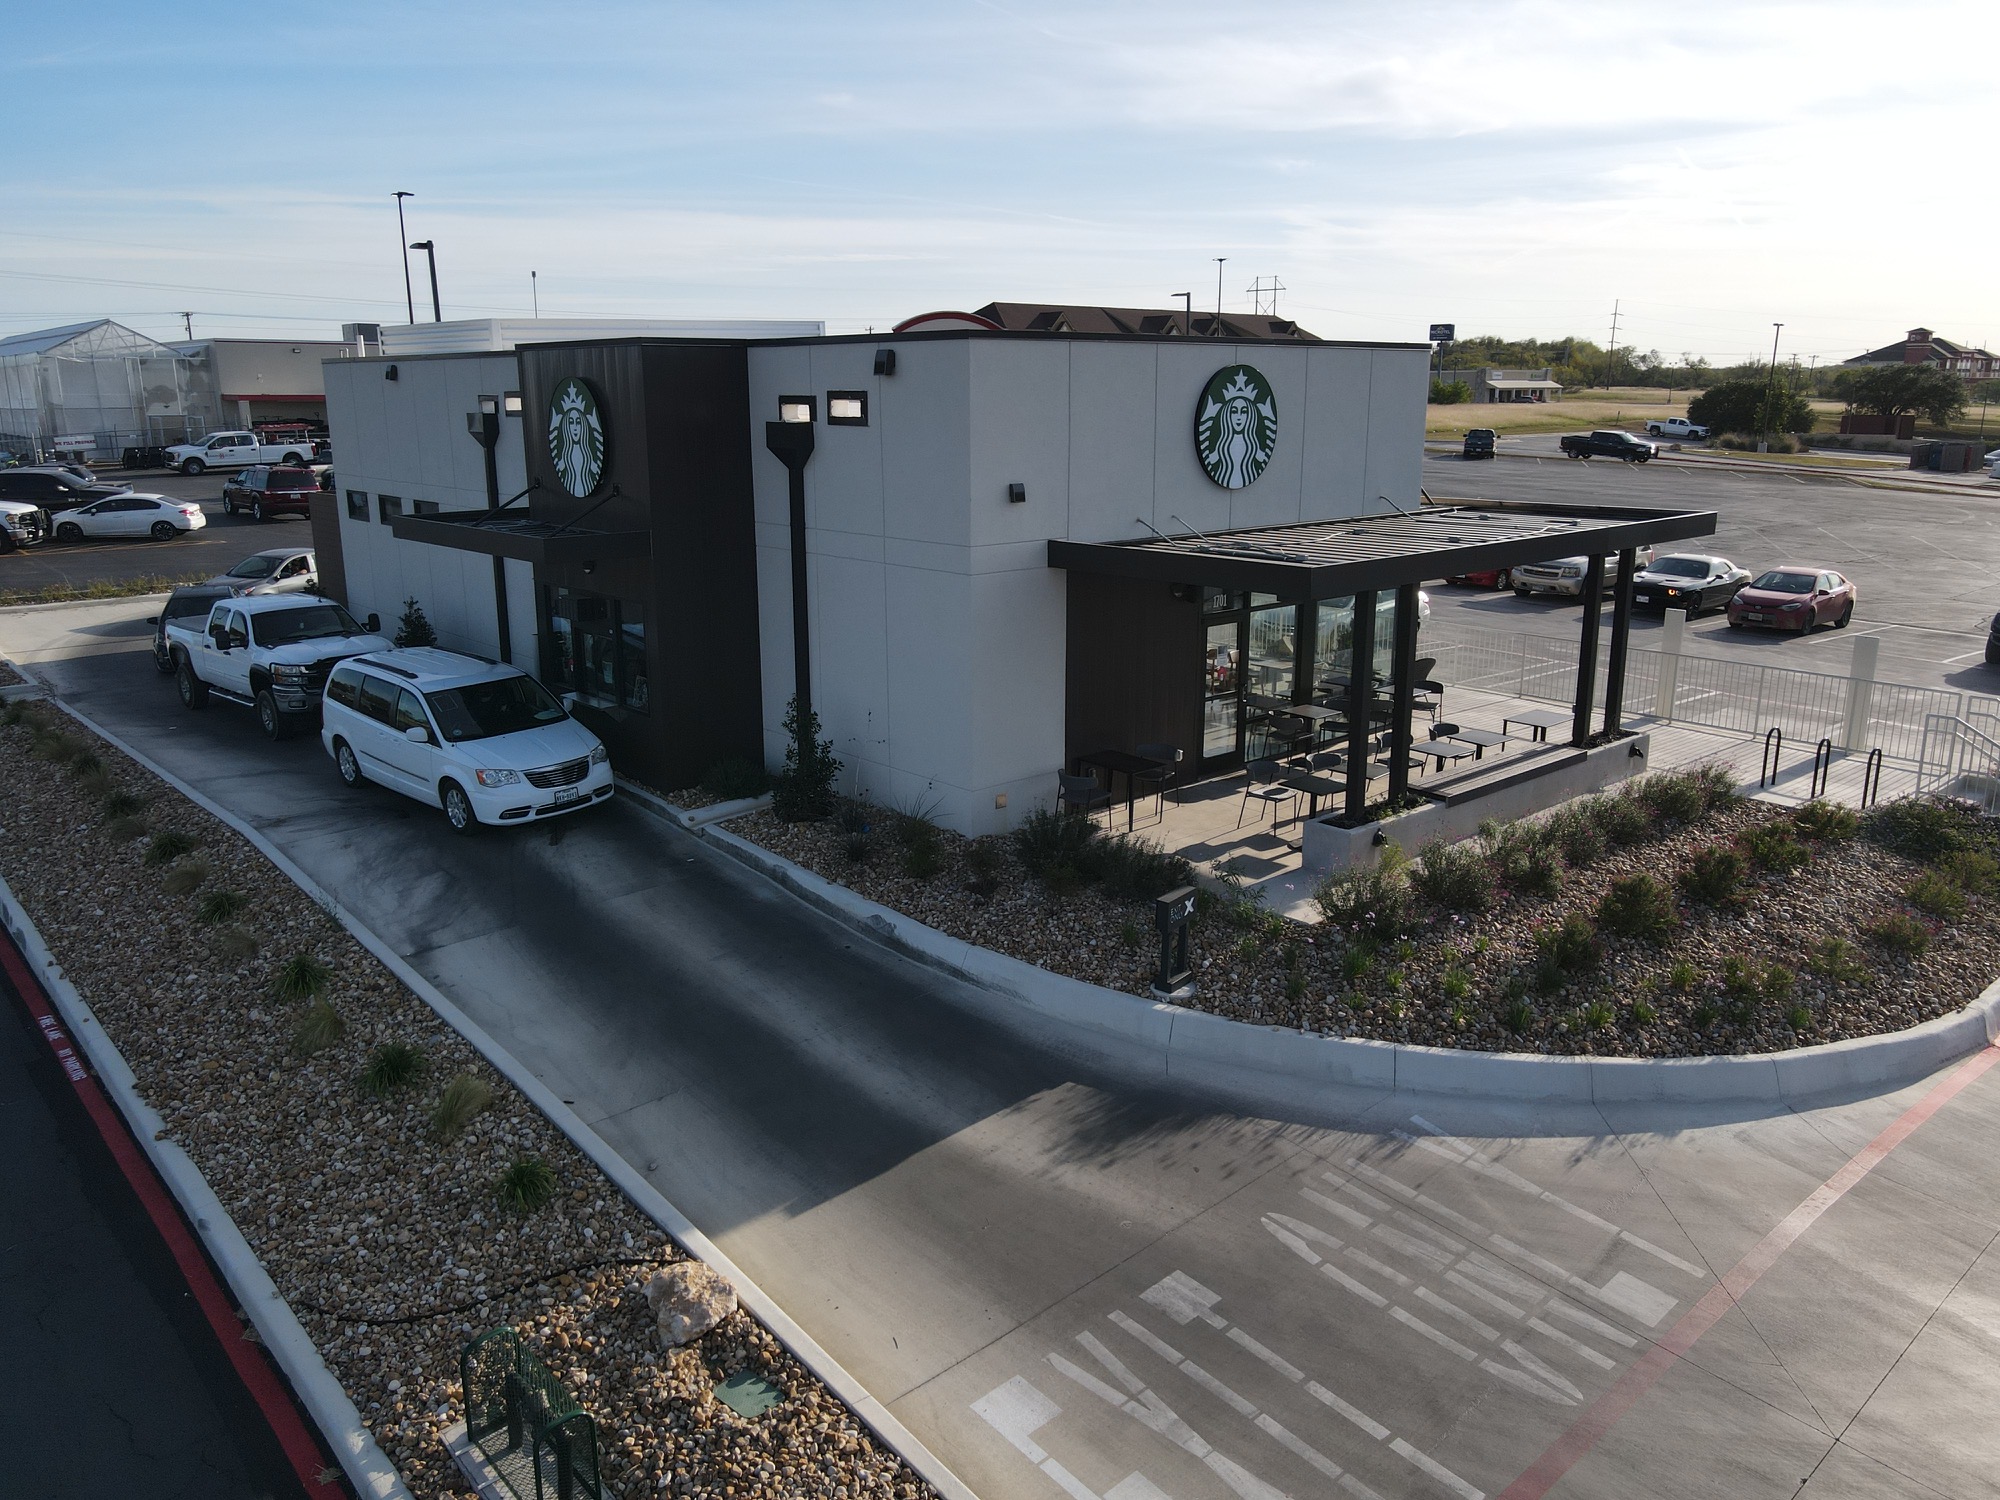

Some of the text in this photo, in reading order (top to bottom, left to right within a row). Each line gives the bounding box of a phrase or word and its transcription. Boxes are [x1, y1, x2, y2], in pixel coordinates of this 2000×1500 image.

[1213, 594, 1227, 608] 1701
[1170, 903, 1182, 916] EXIT
[1170, 911, 1184, 924] ONLY
[38, 1014, 65, 1041] FIRE LANE
[58, 1047, 88, 1081] NO PARKING
[1261, 1114, 1706, 1406] ONLY
